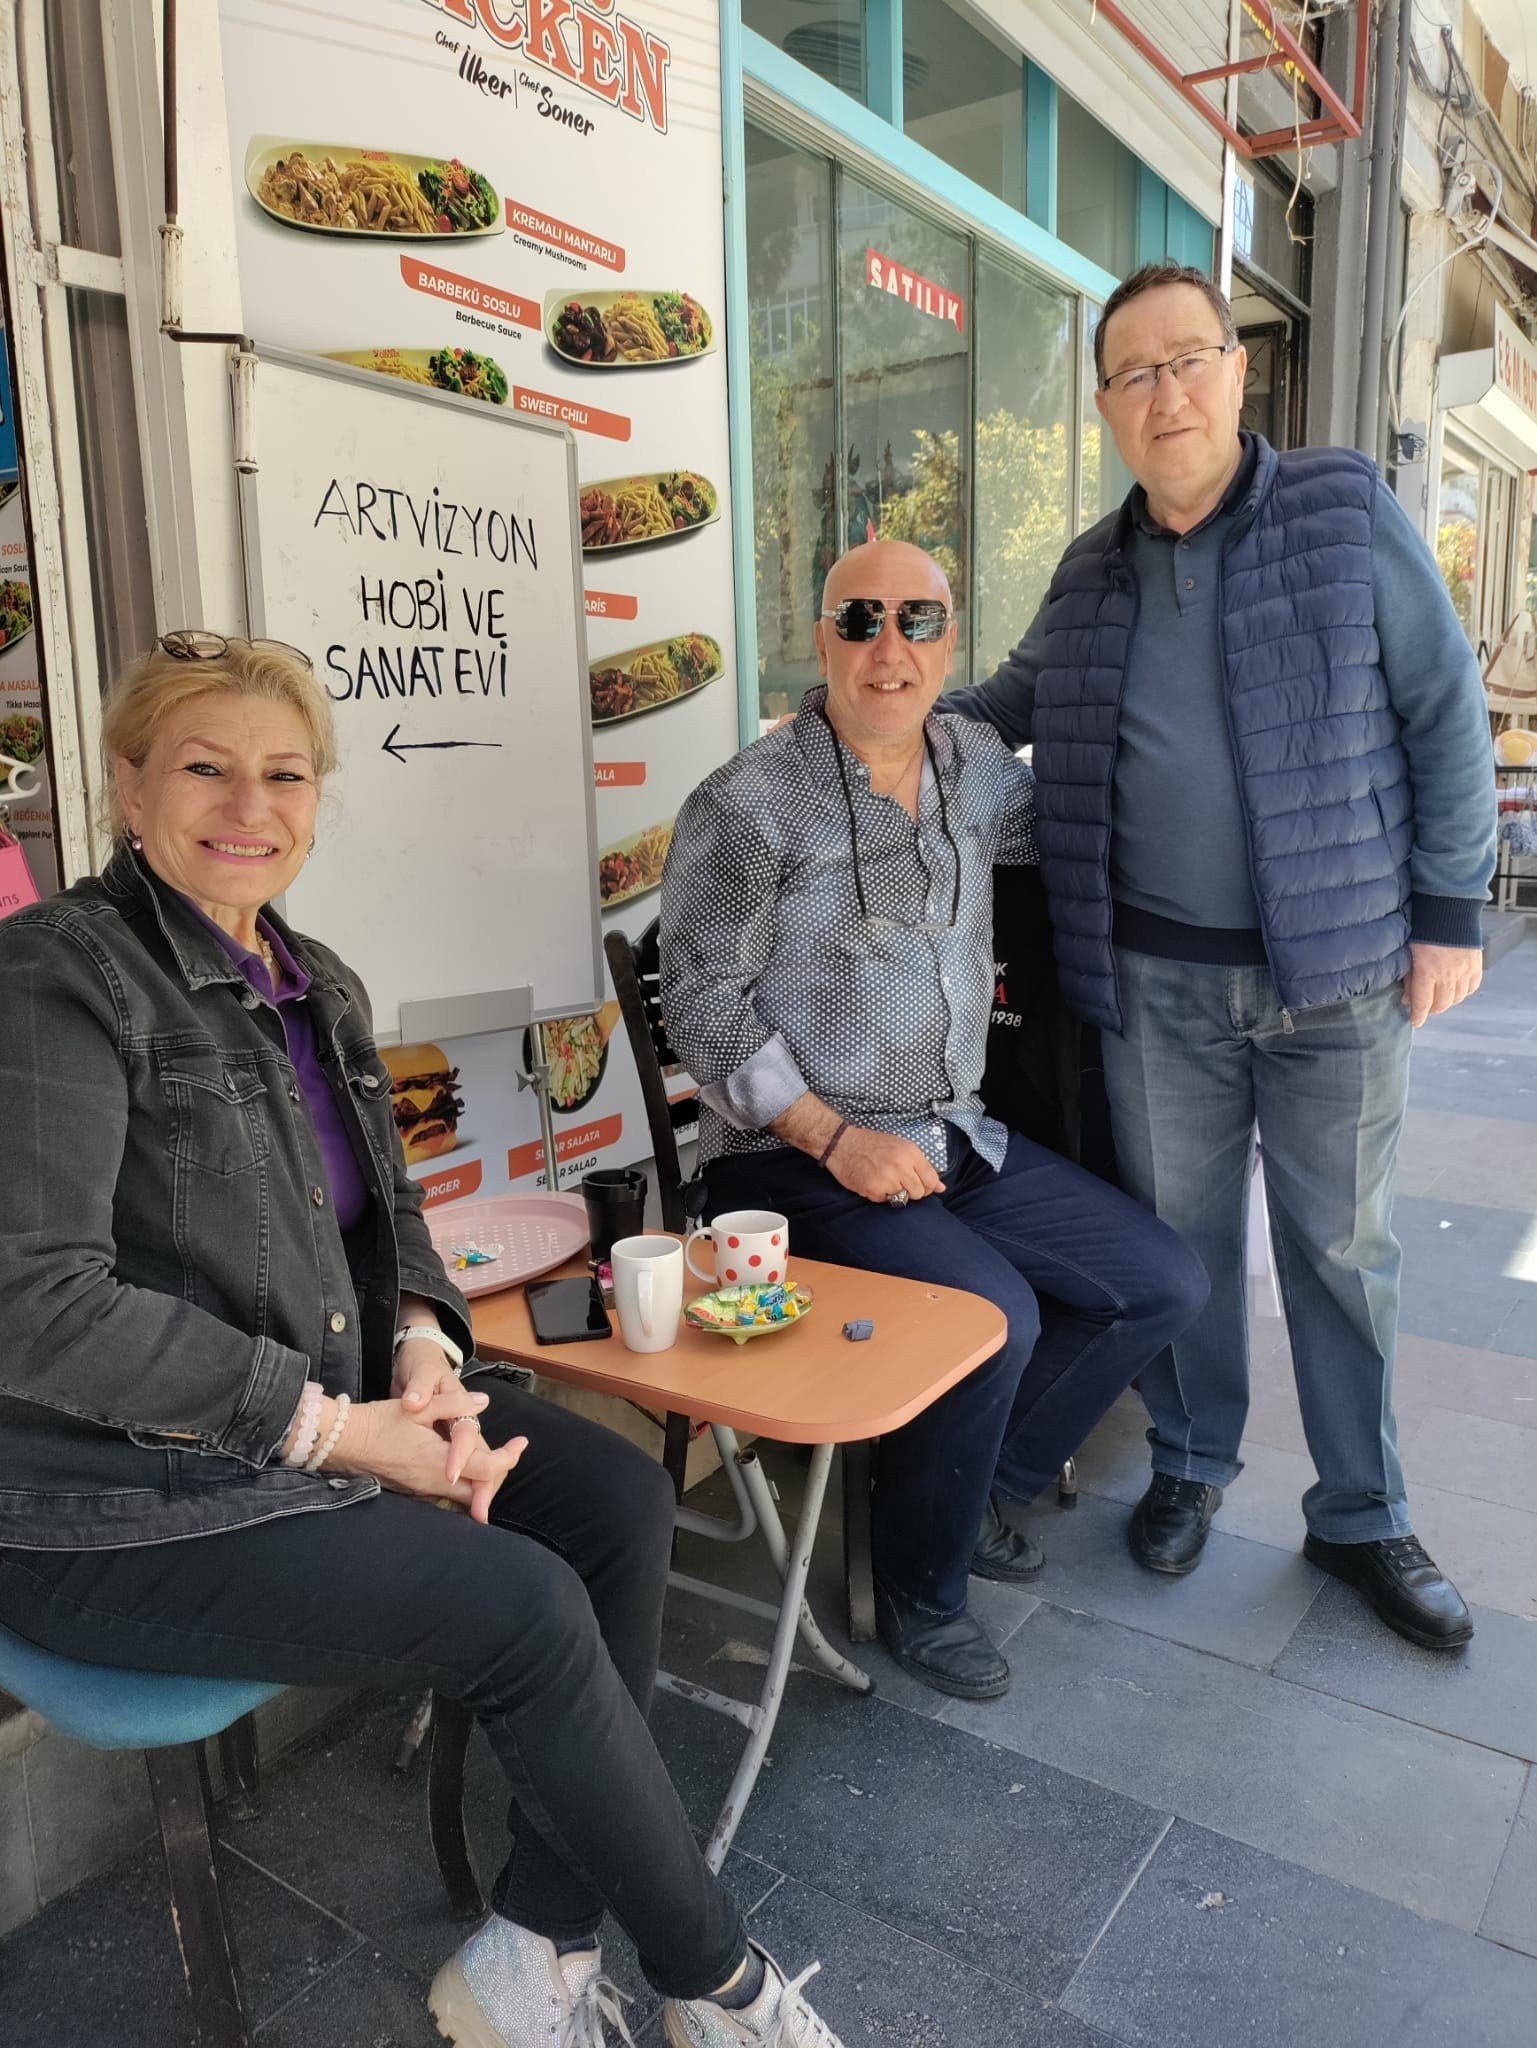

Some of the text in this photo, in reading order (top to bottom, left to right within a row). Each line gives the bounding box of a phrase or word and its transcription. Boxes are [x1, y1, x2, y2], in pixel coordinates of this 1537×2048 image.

[435, 30, 460, 53] Chef
[519, 72, 595, 136] Chef Soner
[512, 208, 617, 264] KREMALI MANTARLI
[513, 234, 588, 271] Creamy Mushrooms
[418, 271, 521, 318] BARBEKÜ SOSLU
[870, 257, 960, 326] SATILIK
[455, 310, 522, 340] Barbecue Sauce
[520, 395, 588, 425] SWEET CHILI
[314, 479, 538, 571] ARTVİZYON
[361, 568, 508, 638] HOBİ VE
[324, 640, 508, 701] SANAT EVİ
[991, 1010, 1022, 1027] 1938
[567, 1130, 600, 1149] SALATA
[568, 1157, 597, 1176] SALAD
